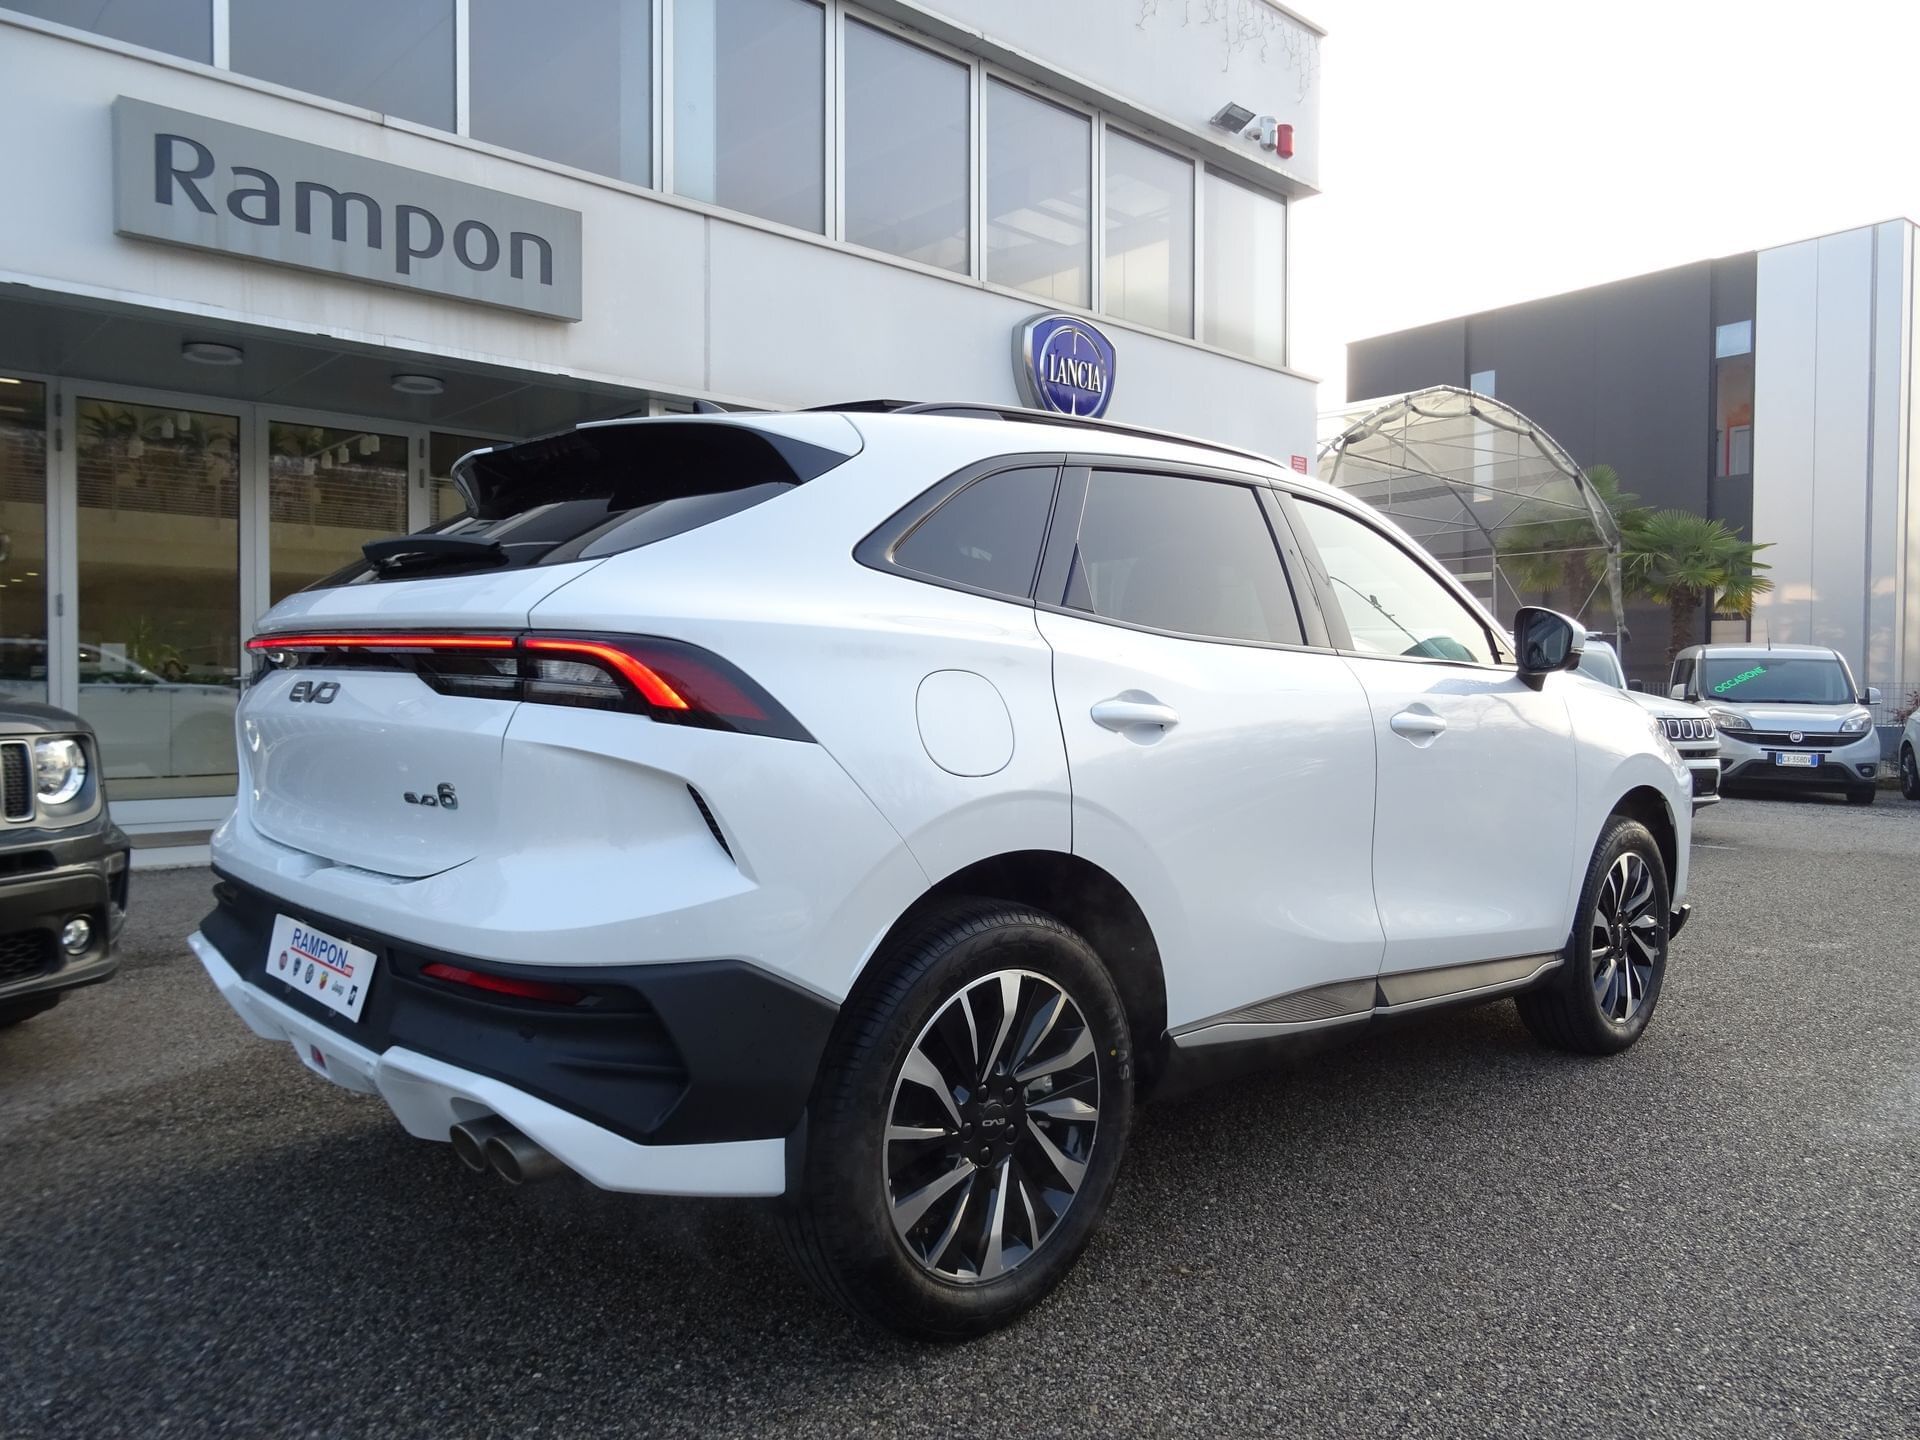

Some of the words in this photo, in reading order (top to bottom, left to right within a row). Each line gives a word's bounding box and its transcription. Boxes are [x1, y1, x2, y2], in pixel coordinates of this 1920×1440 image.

[154, 132, 553, 286] Rampon
[1048, 353, 1102, 393] LANCIA
[289, 680, 342, 704] EVO
[1714, 665, 1767, 693] OCCASIONE
[291, 927, 349, 969] RAMPON
